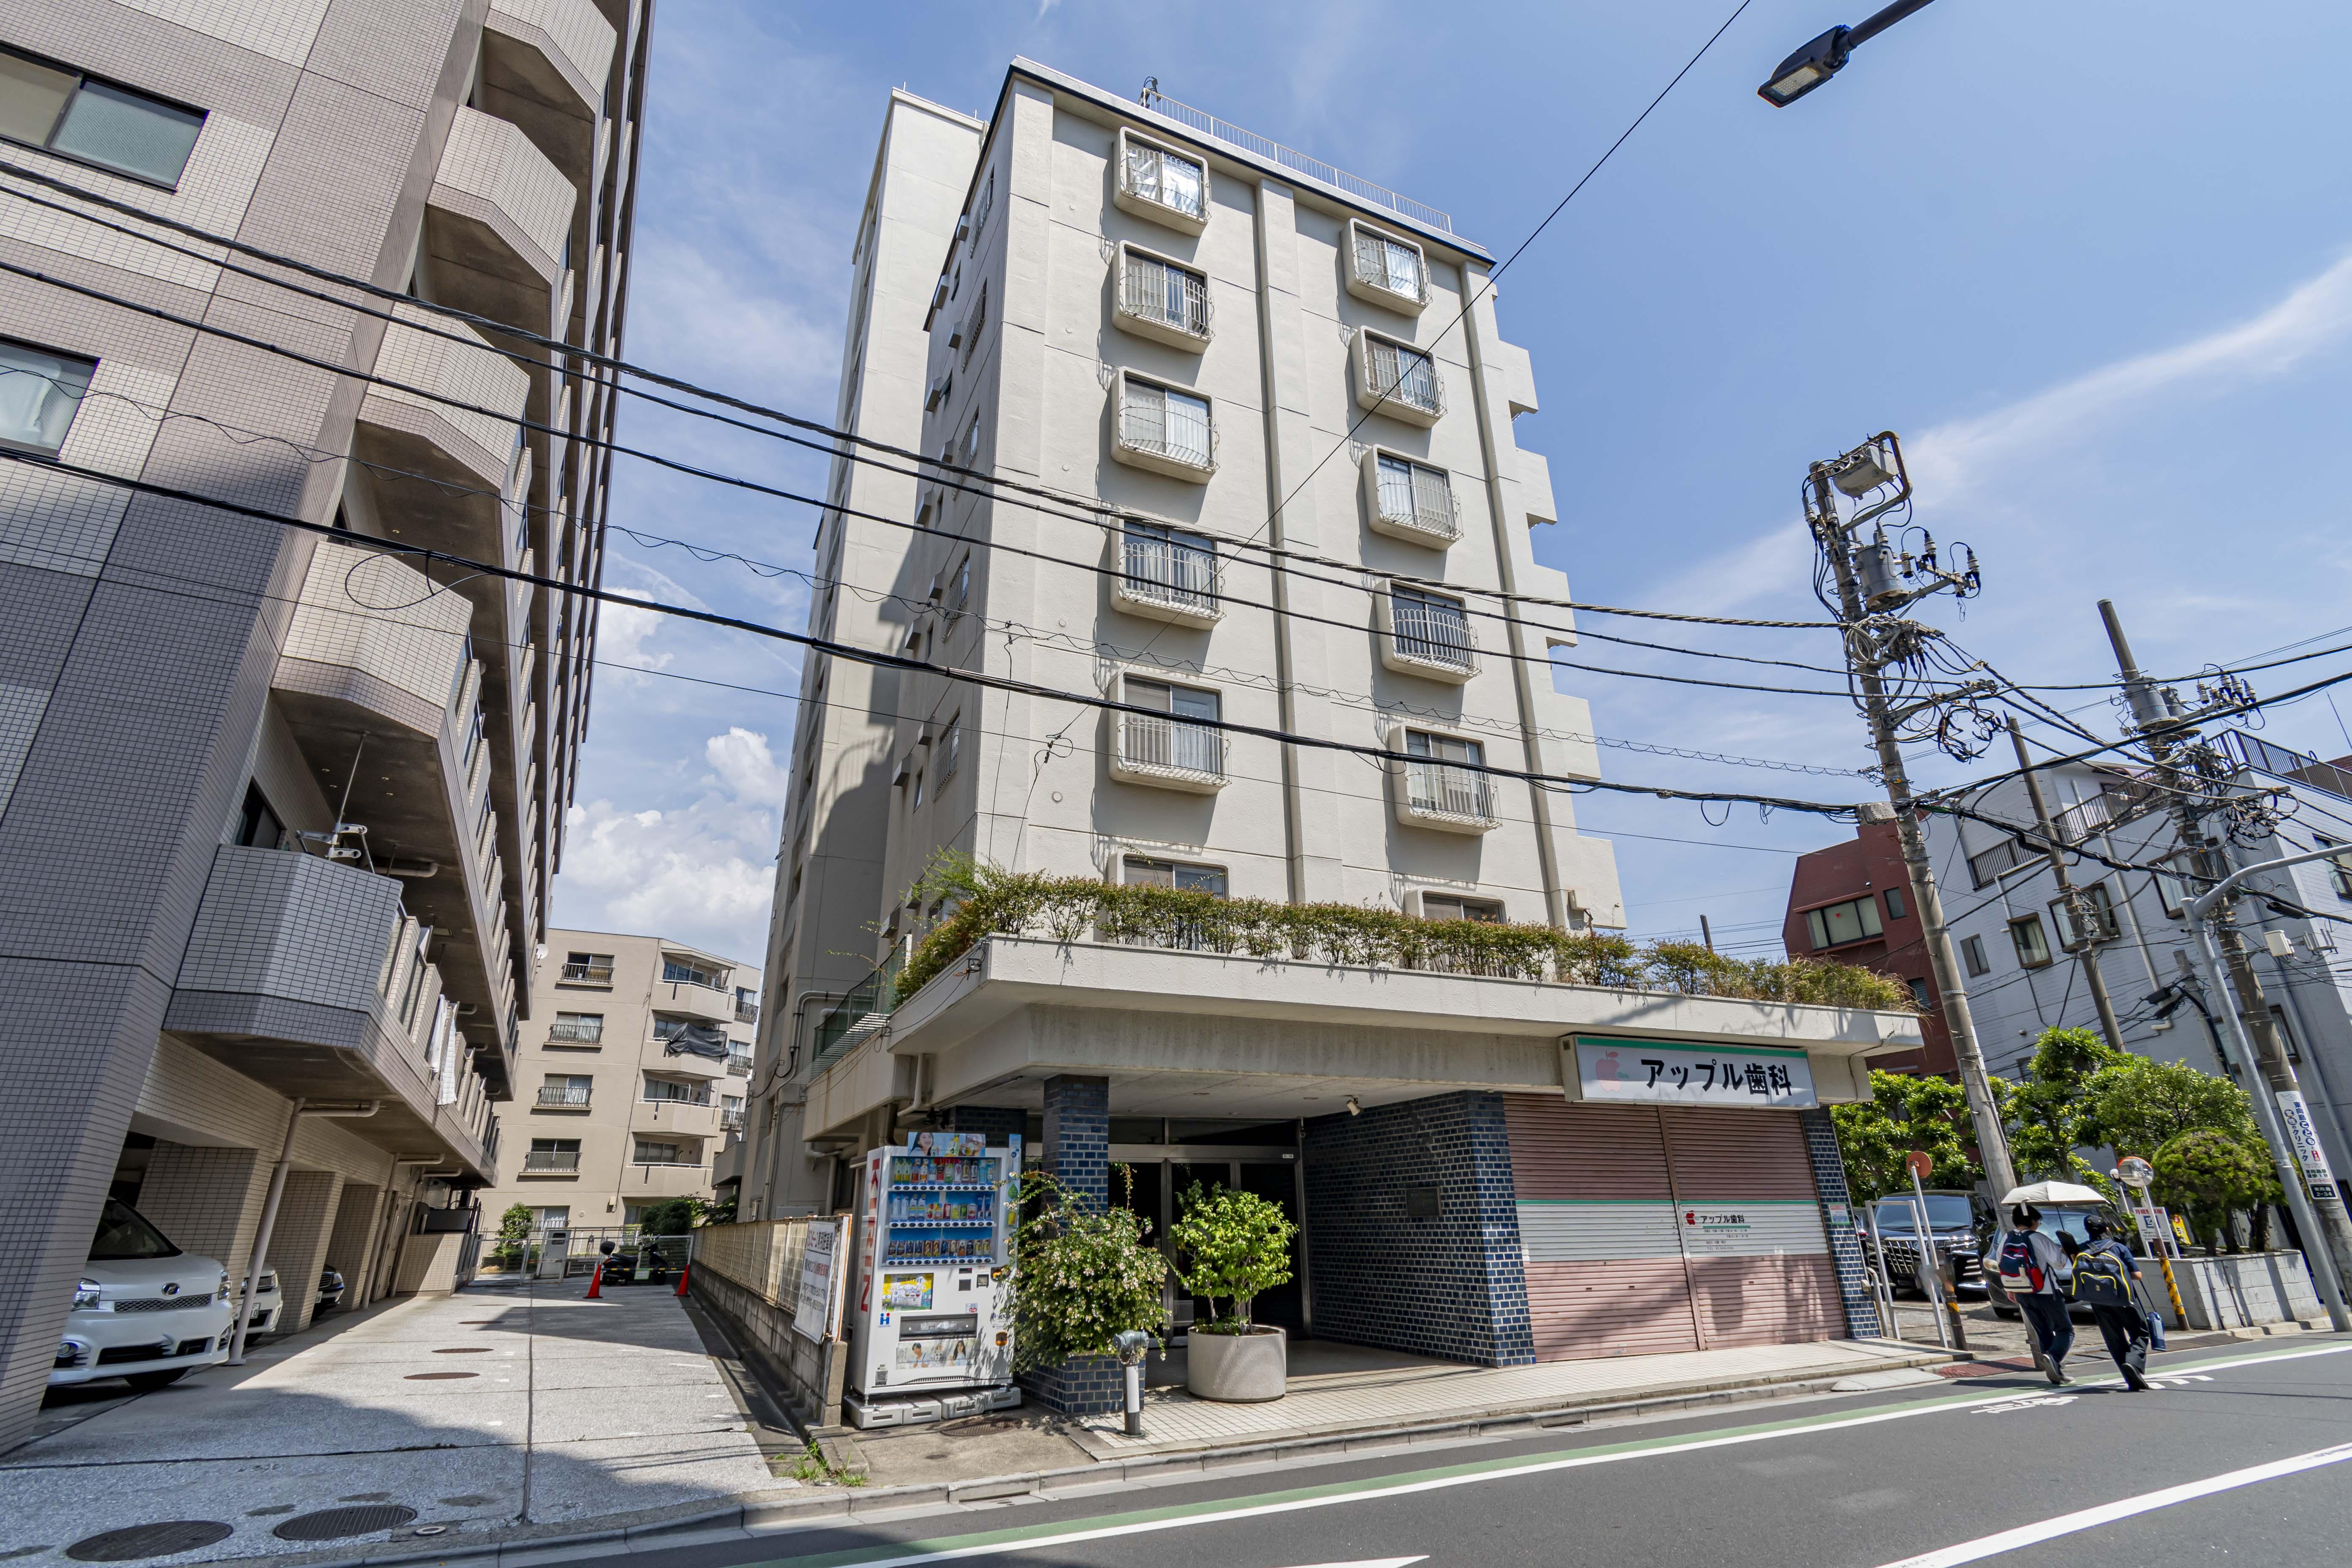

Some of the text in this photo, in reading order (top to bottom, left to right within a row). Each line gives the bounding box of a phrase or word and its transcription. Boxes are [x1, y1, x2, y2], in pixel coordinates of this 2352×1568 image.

[1641, 1058, 1792, 1096] アップル歯科
[861, 1158, 880, 1312] KIRIN
[1700, 1214, 1745, 1223] アップル歯科
